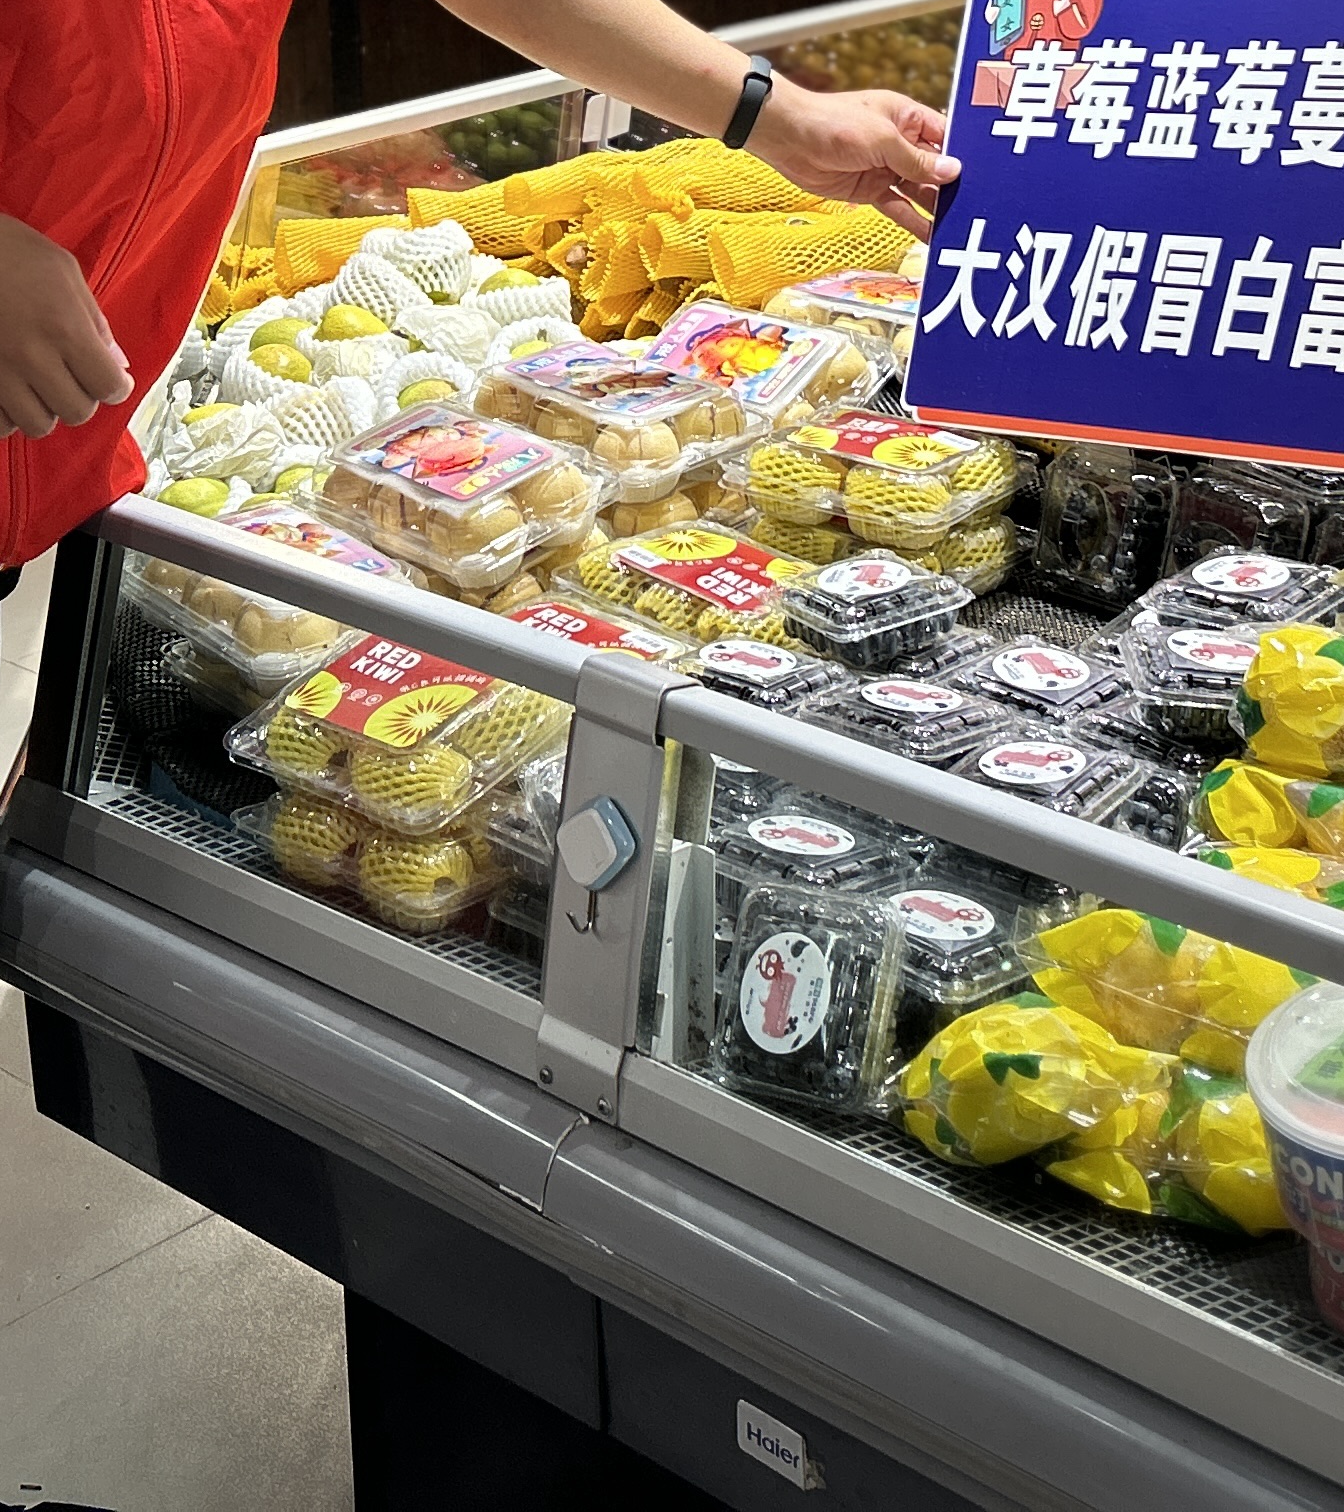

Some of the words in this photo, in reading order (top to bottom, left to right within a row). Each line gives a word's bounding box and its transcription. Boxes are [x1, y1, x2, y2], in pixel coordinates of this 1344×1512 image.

[695, 574, 753, 606] RED
[534, 607, 588, 633] RED
[349, 655, 405, 685] KIWI
[366, 640, 422, 670] RED
[746, 1421, 800, 1469] Haier
